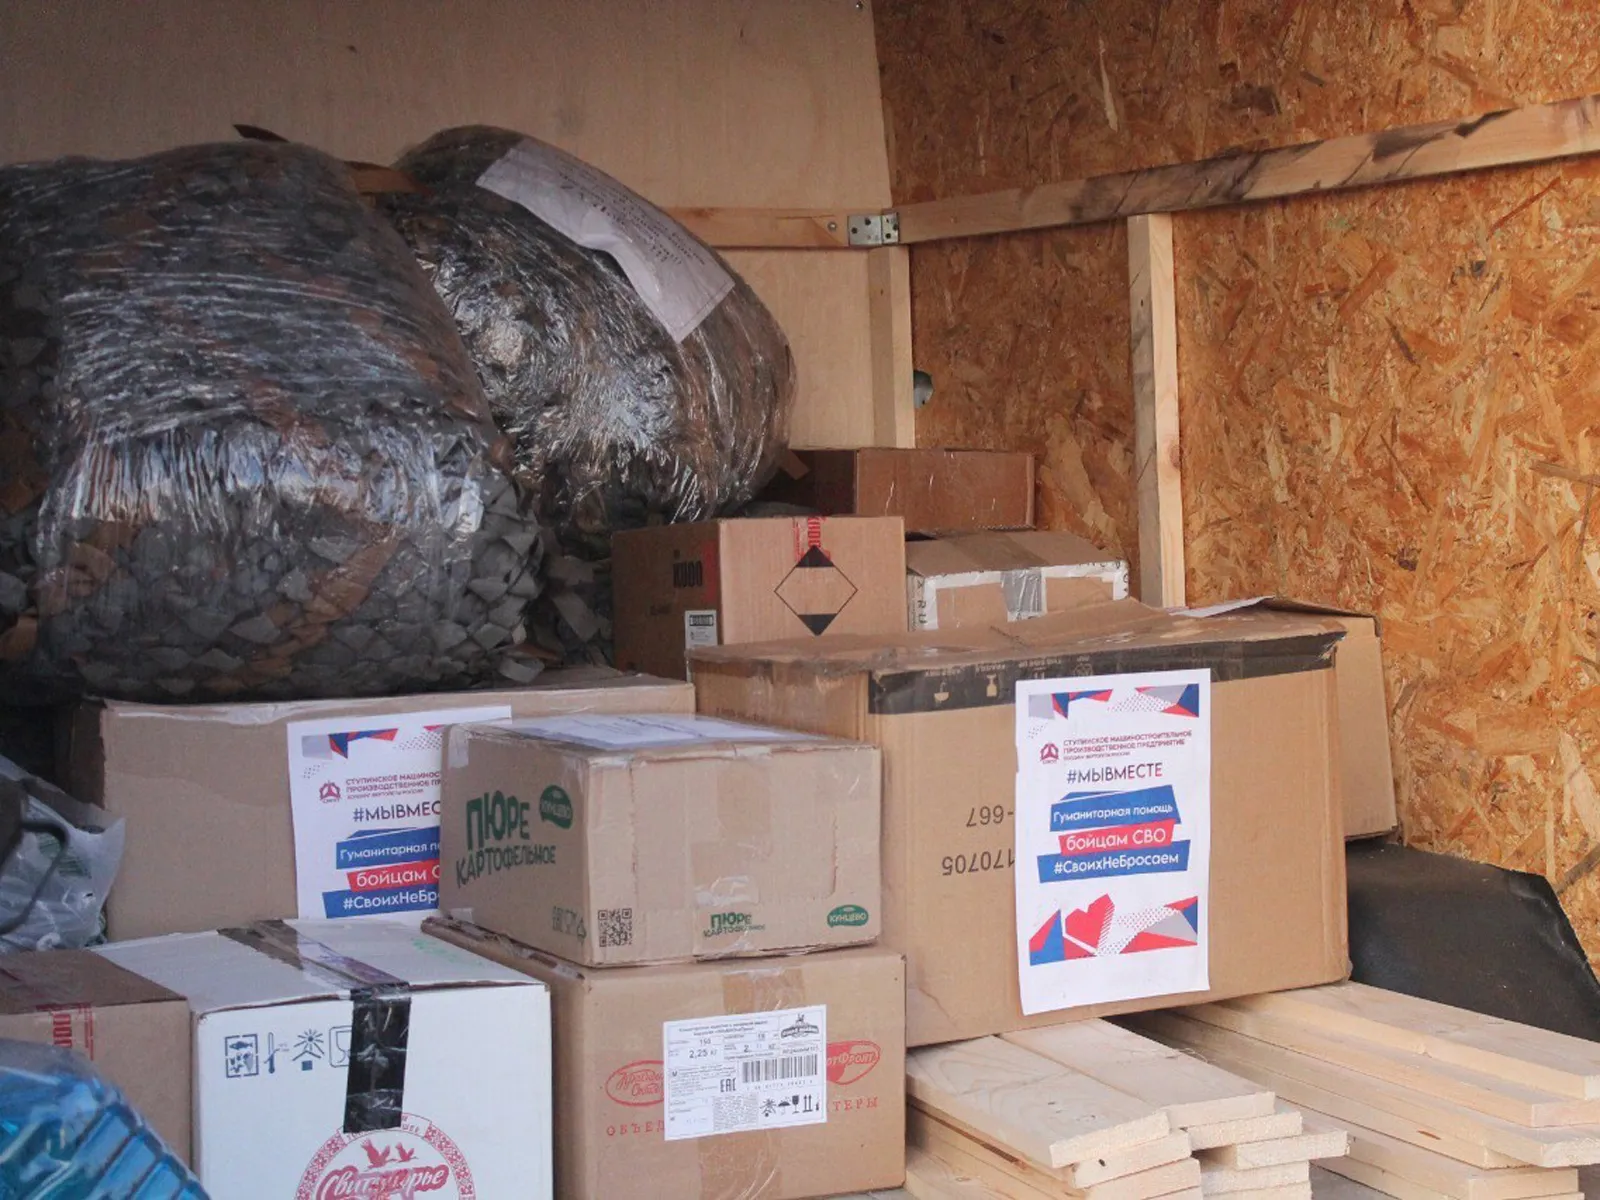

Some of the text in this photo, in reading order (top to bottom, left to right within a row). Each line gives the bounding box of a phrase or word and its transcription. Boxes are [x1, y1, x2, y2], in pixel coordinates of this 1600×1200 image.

[346, 774, 397, 785] СТУПИНСКОЕ
[1067, 762, 1163, 784] #МЫВМЕСТЕ
[346, 780, 430, 793] ПРОИЗВОДСТВЕННОЕ
[466, 790, 530, 850] ПЮРЕ
[1053, 804, 1174, 824] Гуманитарная помощь
[1066, 829, 1166, 851] бойцам СВО
[339, 844, 432, 862] Гуманитарная
[1054, 852, 1179, 874] #СвоихНеБросаем
[356, 866, 427, 888] бойцам
[456, 844, 556, 888] КАРТОФЕЛЬНОЕ
[710, 912, 752, 929] ПЮРЕ
